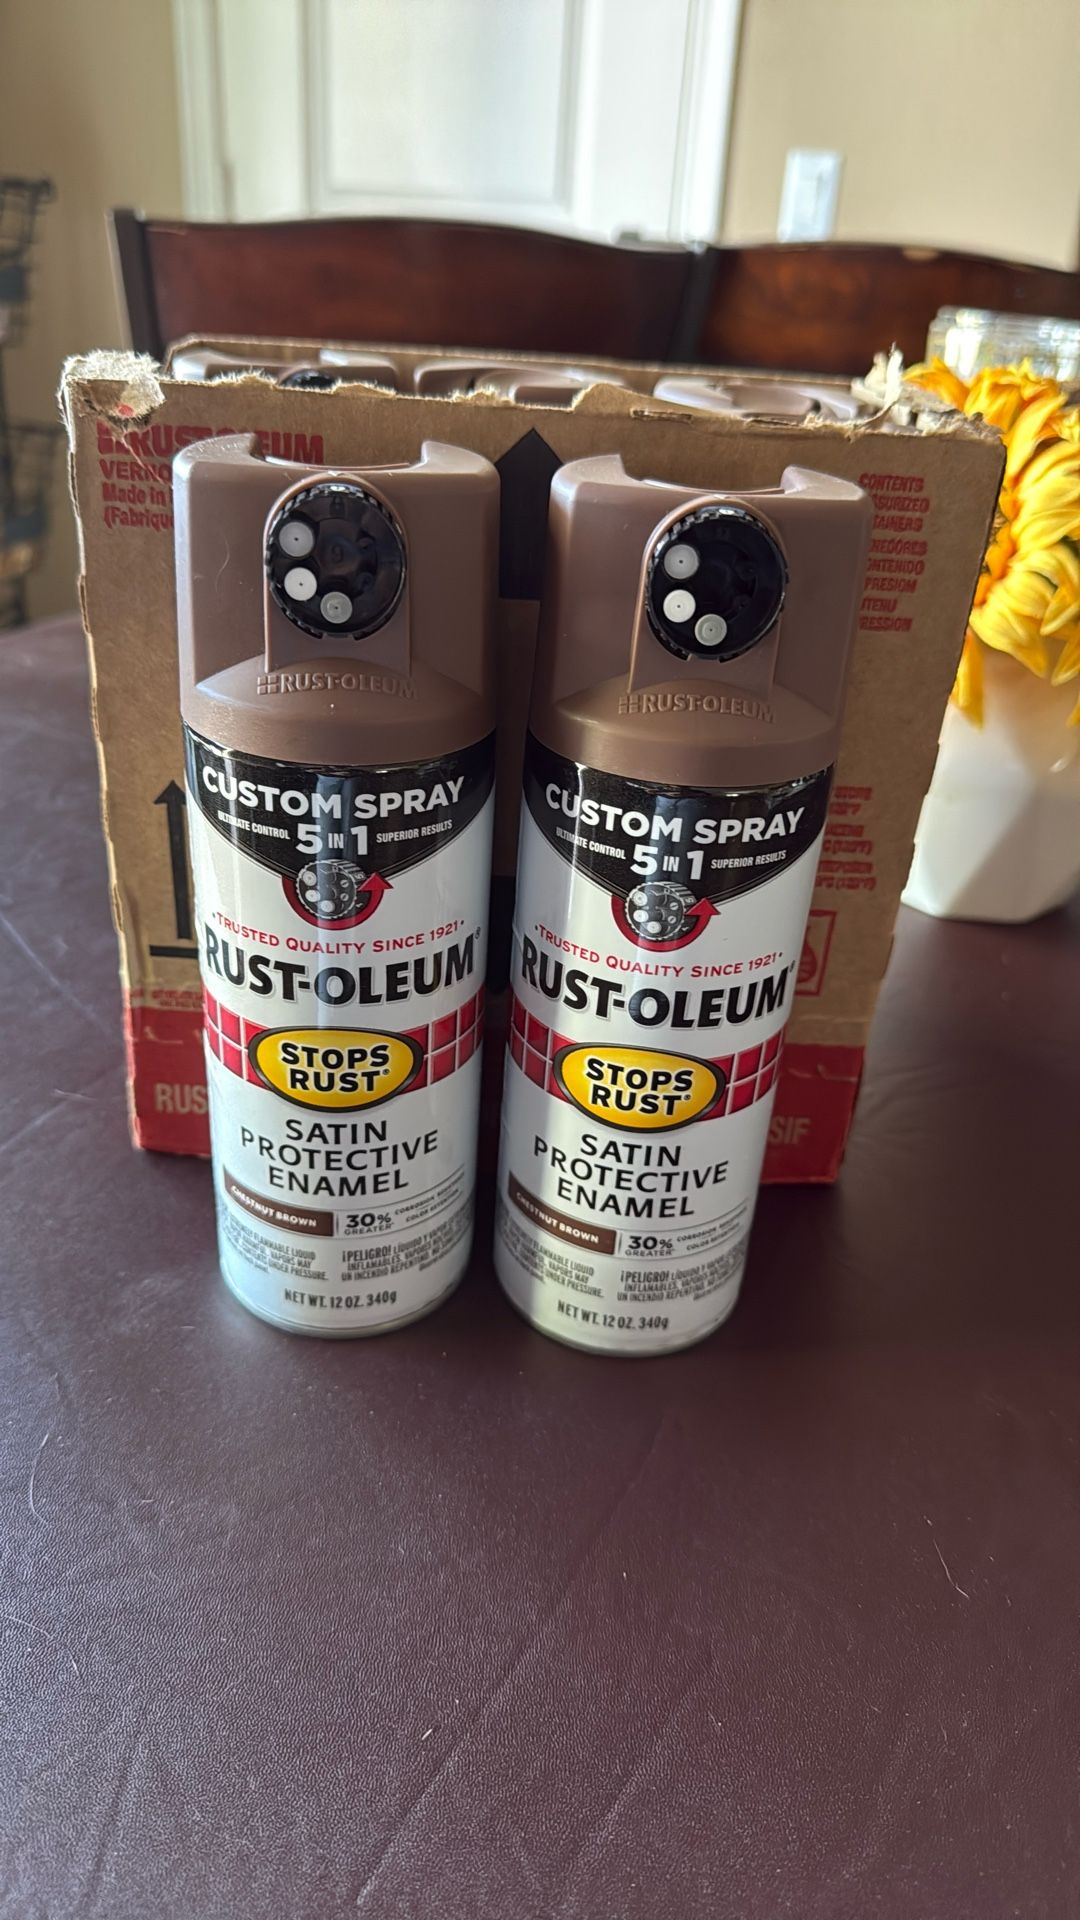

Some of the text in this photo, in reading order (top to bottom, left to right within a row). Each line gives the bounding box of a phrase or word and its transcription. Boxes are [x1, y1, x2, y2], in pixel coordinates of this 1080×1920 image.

[100, 460, 173, 484] VERNO
[859, 473, 924, 492] CONTENTS
[102, 482, 166, 506] Made in
[104, 506, 174, 532] (Fabriqu
[280, 673, 417, 700] RUST-OLEUM
[642, 693, 777, 722] RUST-OLEUM
[202, 766, 465, 819] CUSTOM SPRAY
[217, 811, 291, 840] ULTIMATE CONTROL
[546, 783, 805, 845] CUSTOM SPRAY
[295, 823, 368, 855] 5 IN 1
[376, 819, 453, 843] SUPERIOR RESULTS
[556, 827, 626, 860] ULTIMATE CONTROL
[630, 844, 704, 880] 5 IN 1
[711, 849, 787, 869] SUPERIOR RESULTS
[216, 911, 459, 954] TRUSTED QUALITY SINCE 1921
[538, 925, 778, 978] TRUSTED QUALITY SINCE 1921
[281, 1042, 390, 1070] STOPS
[585, 1057, 694, 1092] STOPS
[154, 1082, 208, 1114] RUS
[285, 1119, 388, 1145] SATIN
[768, 1115, 811, 1146] SIF
[240, 1126, 438, 1171] PROTECTIVE
[534, 1135, 729, 1193] PROTECTIVE
[580, 1133, 682, 1167] SATIN
[268, 1166, 409, 1197] ENAMEL
[231, 1185, 275, 1217] CHESTNUT
[275, 1211, 317, 1227] BROWN
[557, 1177, 695, 1218] ENAMEL
[346, 1212, 392, 1229] 30%
[516, 1192, 558, 1228] CHESTNUT
[559, 1222, 599, 1244] BROWN
[628, 1235, 673, 1250] 30%
[284, 1287, 397, 1309] NET WT. 12 OZ. 340g
[557, 1300, 669, 1331] NET WT. 12 OZ. 340g
